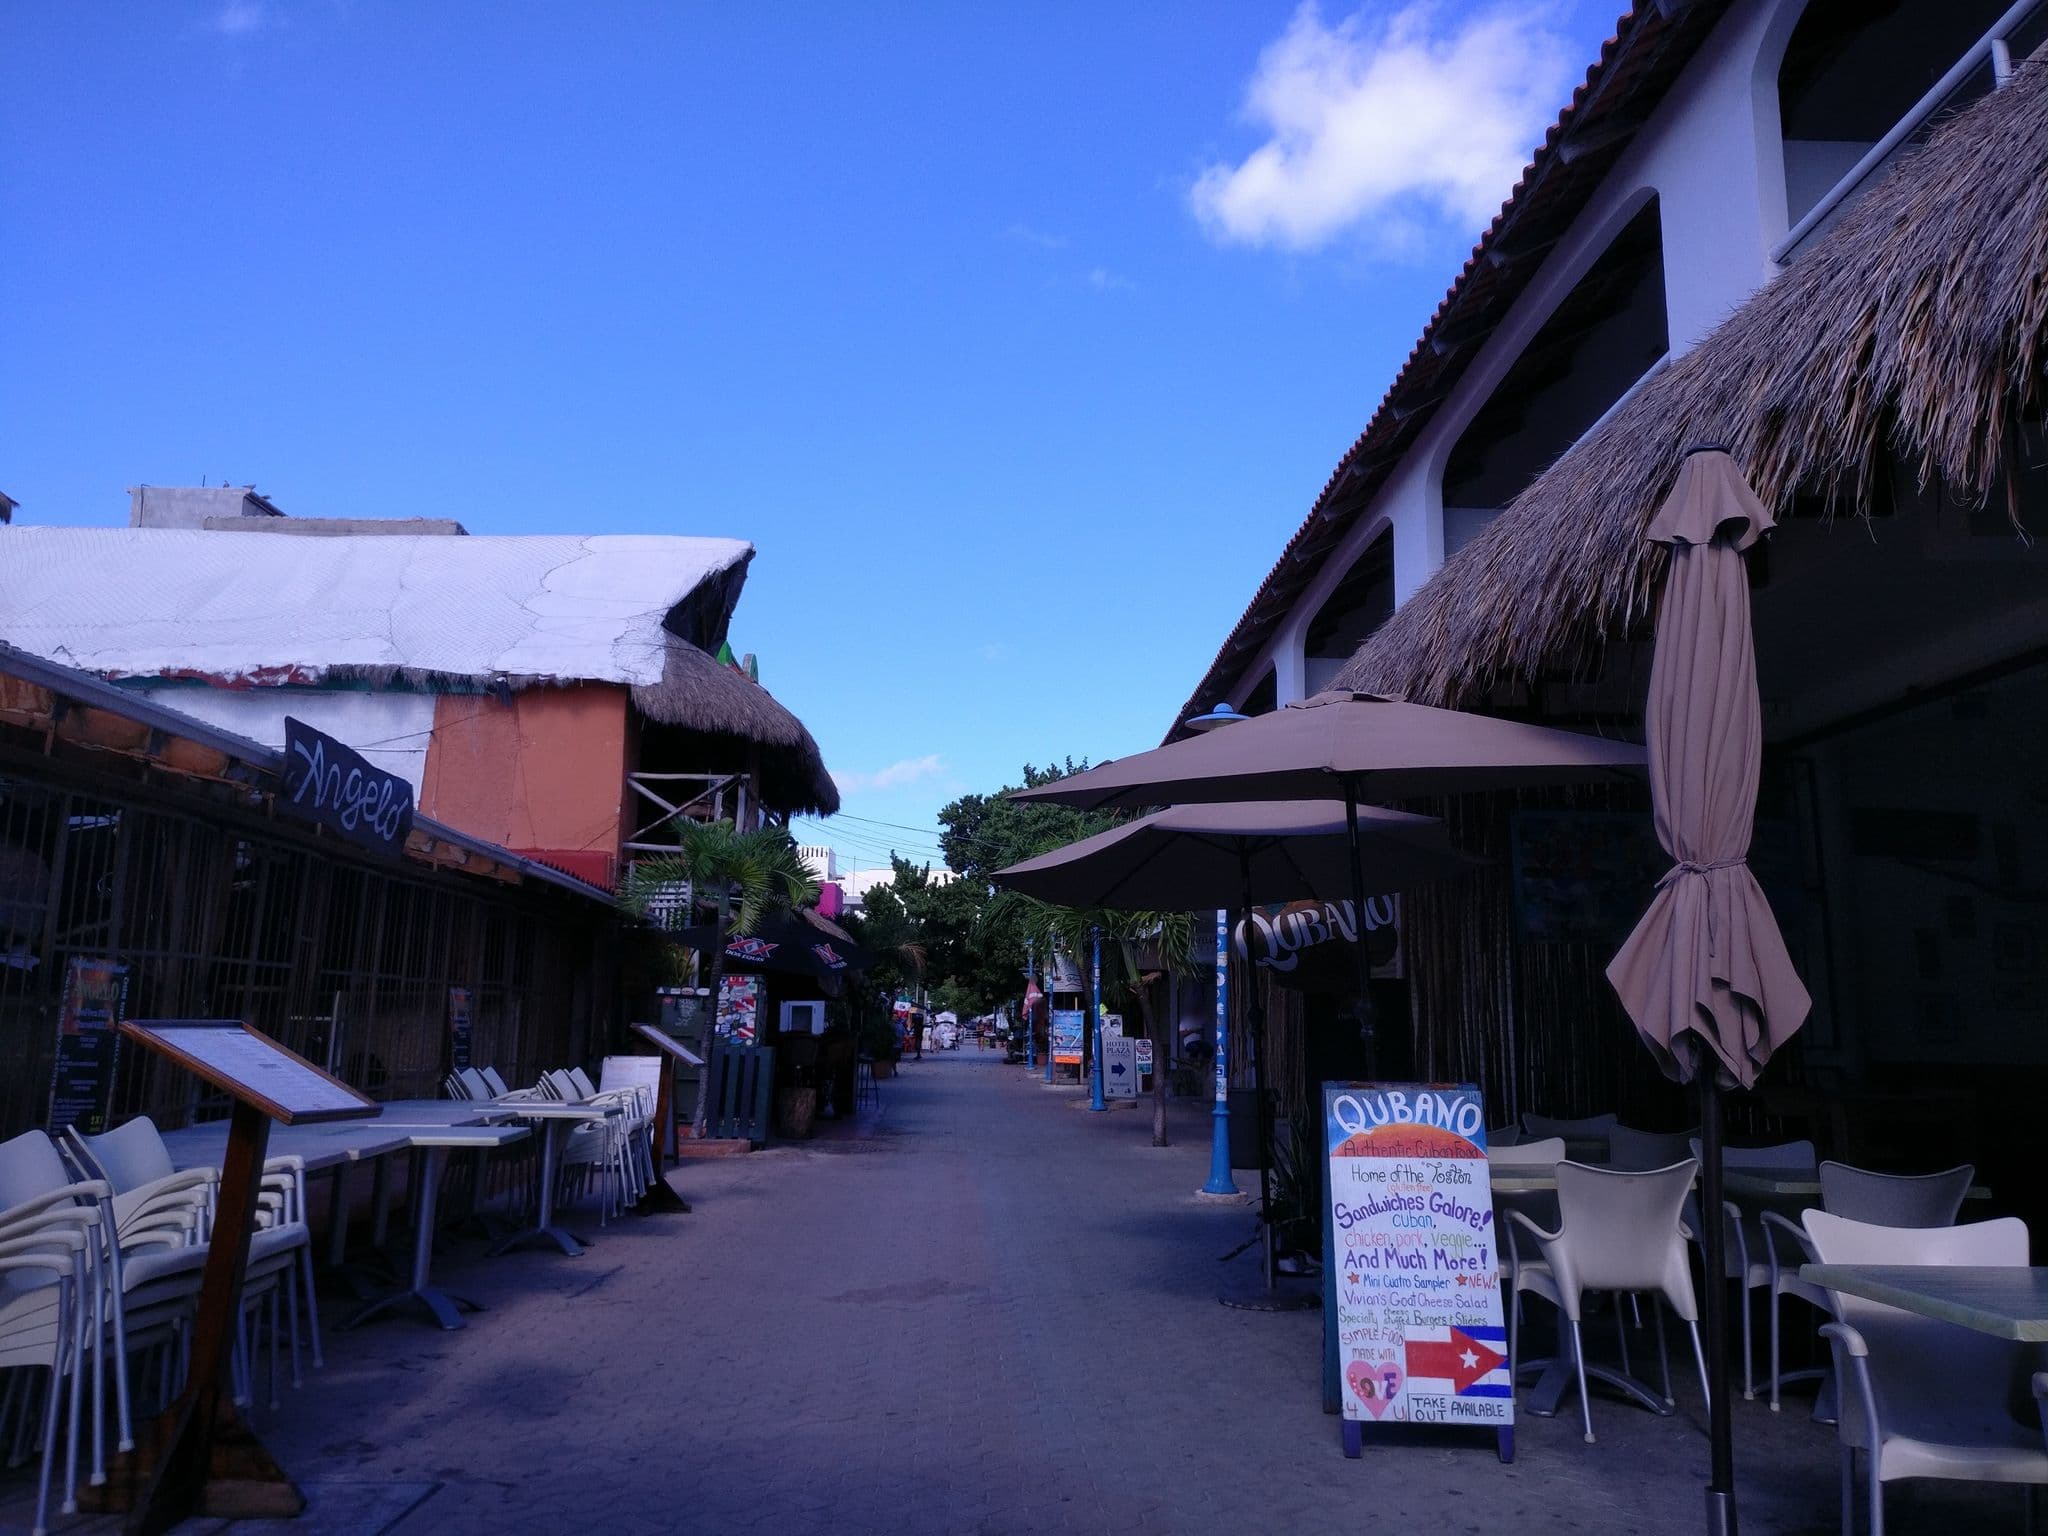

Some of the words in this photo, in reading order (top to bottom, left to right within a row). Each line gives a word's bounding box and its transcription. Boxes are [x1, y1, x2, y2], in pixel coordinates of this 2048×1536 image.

[293, 739, 409, 841] Angelo
[1333, 1091, 1483, 1137] QUBANO
[1344, 1140, 1413, 1158] Authentic
[1415, 1140, 1452, 1158] Cuban
[1453, 1141, 1478, 1158] Food
[1352, 1163, 1386, 1183] Home
[1390, 1164, 1405, 1182] of
[1404, 1164, 1424, 1183] the
[1335, 1193, 1425, 1229] Sandwiches
[1429, 1192, 1492, 1232] Galore!
[1396, 1231, 1428, 1250] pork,
[1344, 1249, 1379, 1269] And
[1385, 1248, 1427, 1270] Much
[1434, 1248, 1488, 1270] More!
[1363, 1275, 1381, 1288] Mini
[1414, 1275, 1451, 1291] Sampler
[1469, 1272, 1498, 1290] NEW!
[1344, 1290, 1387, 1306] Vivian's
[1389, 1291, 1417, 1307] Goat
[1418, 1293, 1453, 1308] Cheese
[1455, 1294, 1489, 1309] Salad
[1414, 1310, 1447, 1330] Burgers
[1456, 1312, 1488, 1326] Sliders
[1342, 1327, 1379, 1345] SIMPLE
[1381, 1327, 1404, 1347] FOOD
[1352, 1347, 1375, 1360] MADE
[1378, 1348, 1395, 1361] WITH
[1412, 1397, 1446, 1409] TAKE
[1451, 1401, 1505, 1418] AVAILABLE
[1415, 1409, 1447, 1421] OUT
